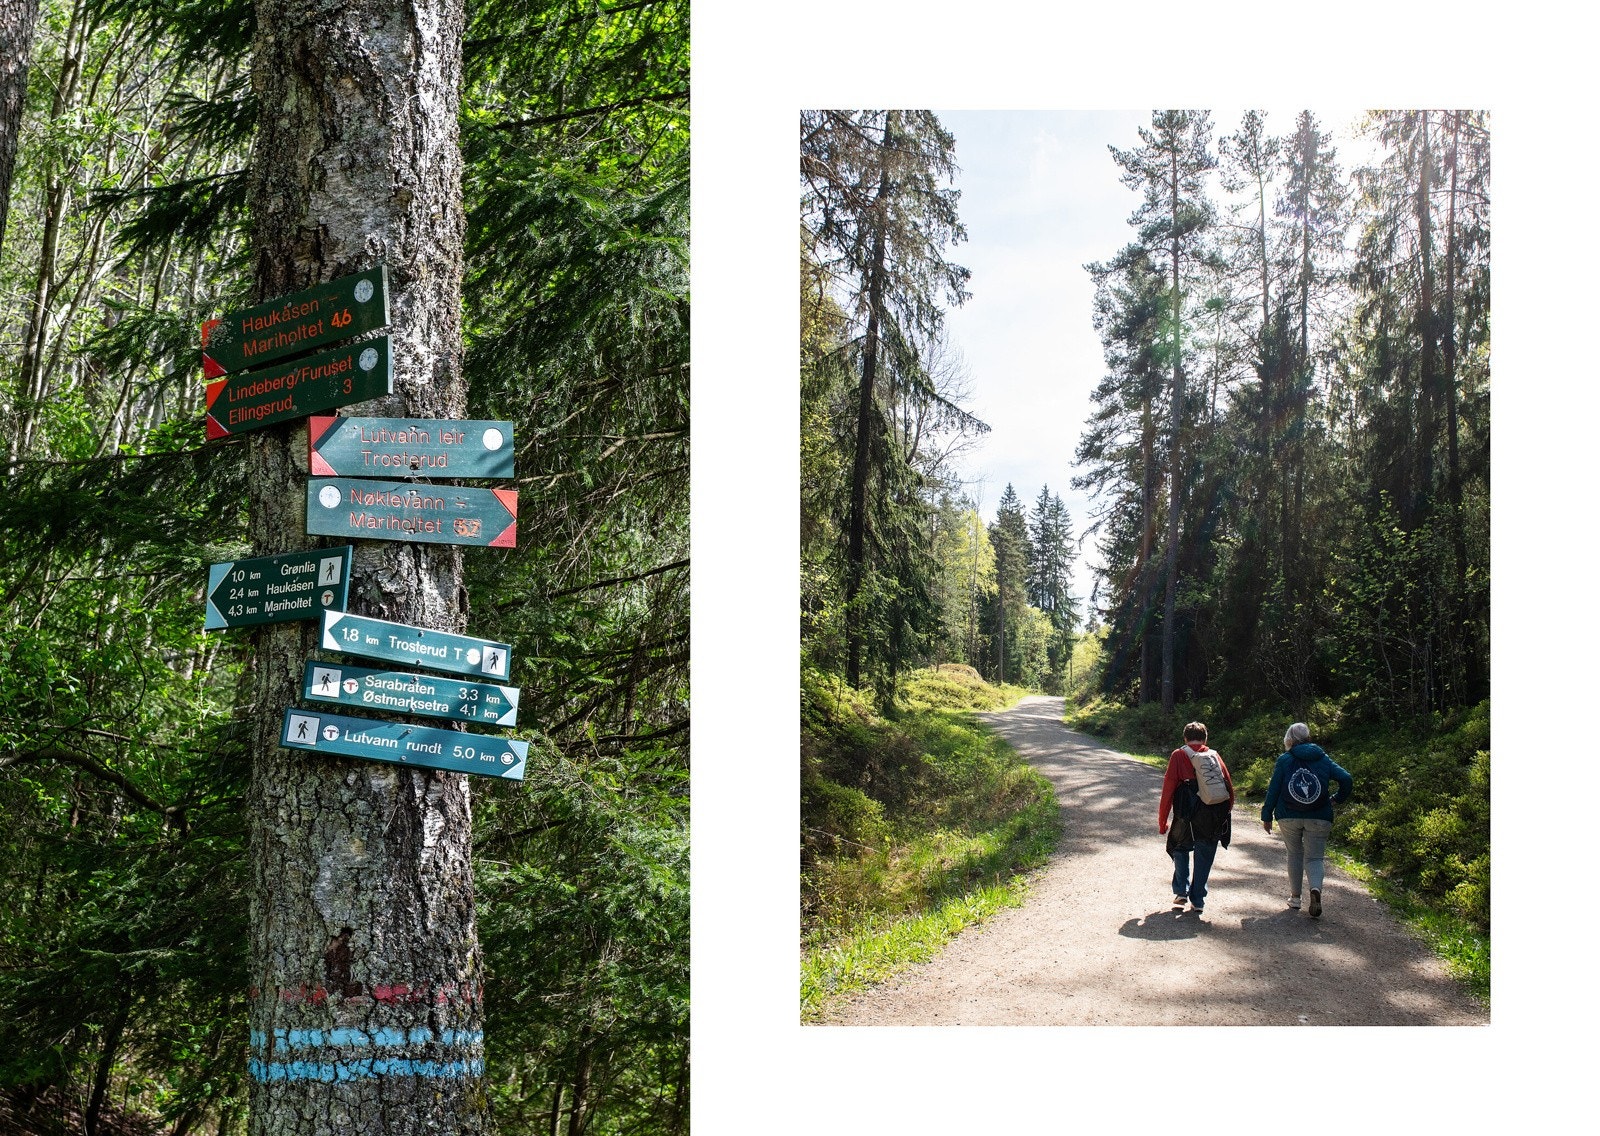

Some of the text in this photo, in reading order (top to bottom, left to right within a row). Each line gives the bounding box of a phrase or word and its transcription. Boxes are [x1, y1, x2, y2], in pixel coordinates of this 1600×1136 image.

[242, 300, 319, 334] Haukåsen
[243, 320, 323, 357] Mariholtet
[229, 355, 353, 402] Lindeberg/Furuset
[229, 379, 353, 425] Ellingsrud 3
[361, 427, 465, 445] Lutvann leir
[361, 451, 448, 468] Trosterud
[351, 489, 445, 510] Nøklevann
[351, 512, 442, 534] Mariholtet
[231, 562, 316, 583] 1,0 km Grønlia
[229, 579, 314, 601] 2,4 km Haukåsen
[228, 596, 312, 617] 4,3 km Mariholtet
[342, 627, 463, 660] 1,8 km Trosterud T
[363, 690, 499, 719] Østmarksetra 4,1 km
[365, 675, 500, 705] Sarabråten 3,3 km
[344, 730, 398, 749] Lutvann
[406, 740, 442, 755] rundt
[452, 746, 475, 760] 5,0
[480, 752, 496, 763] km
